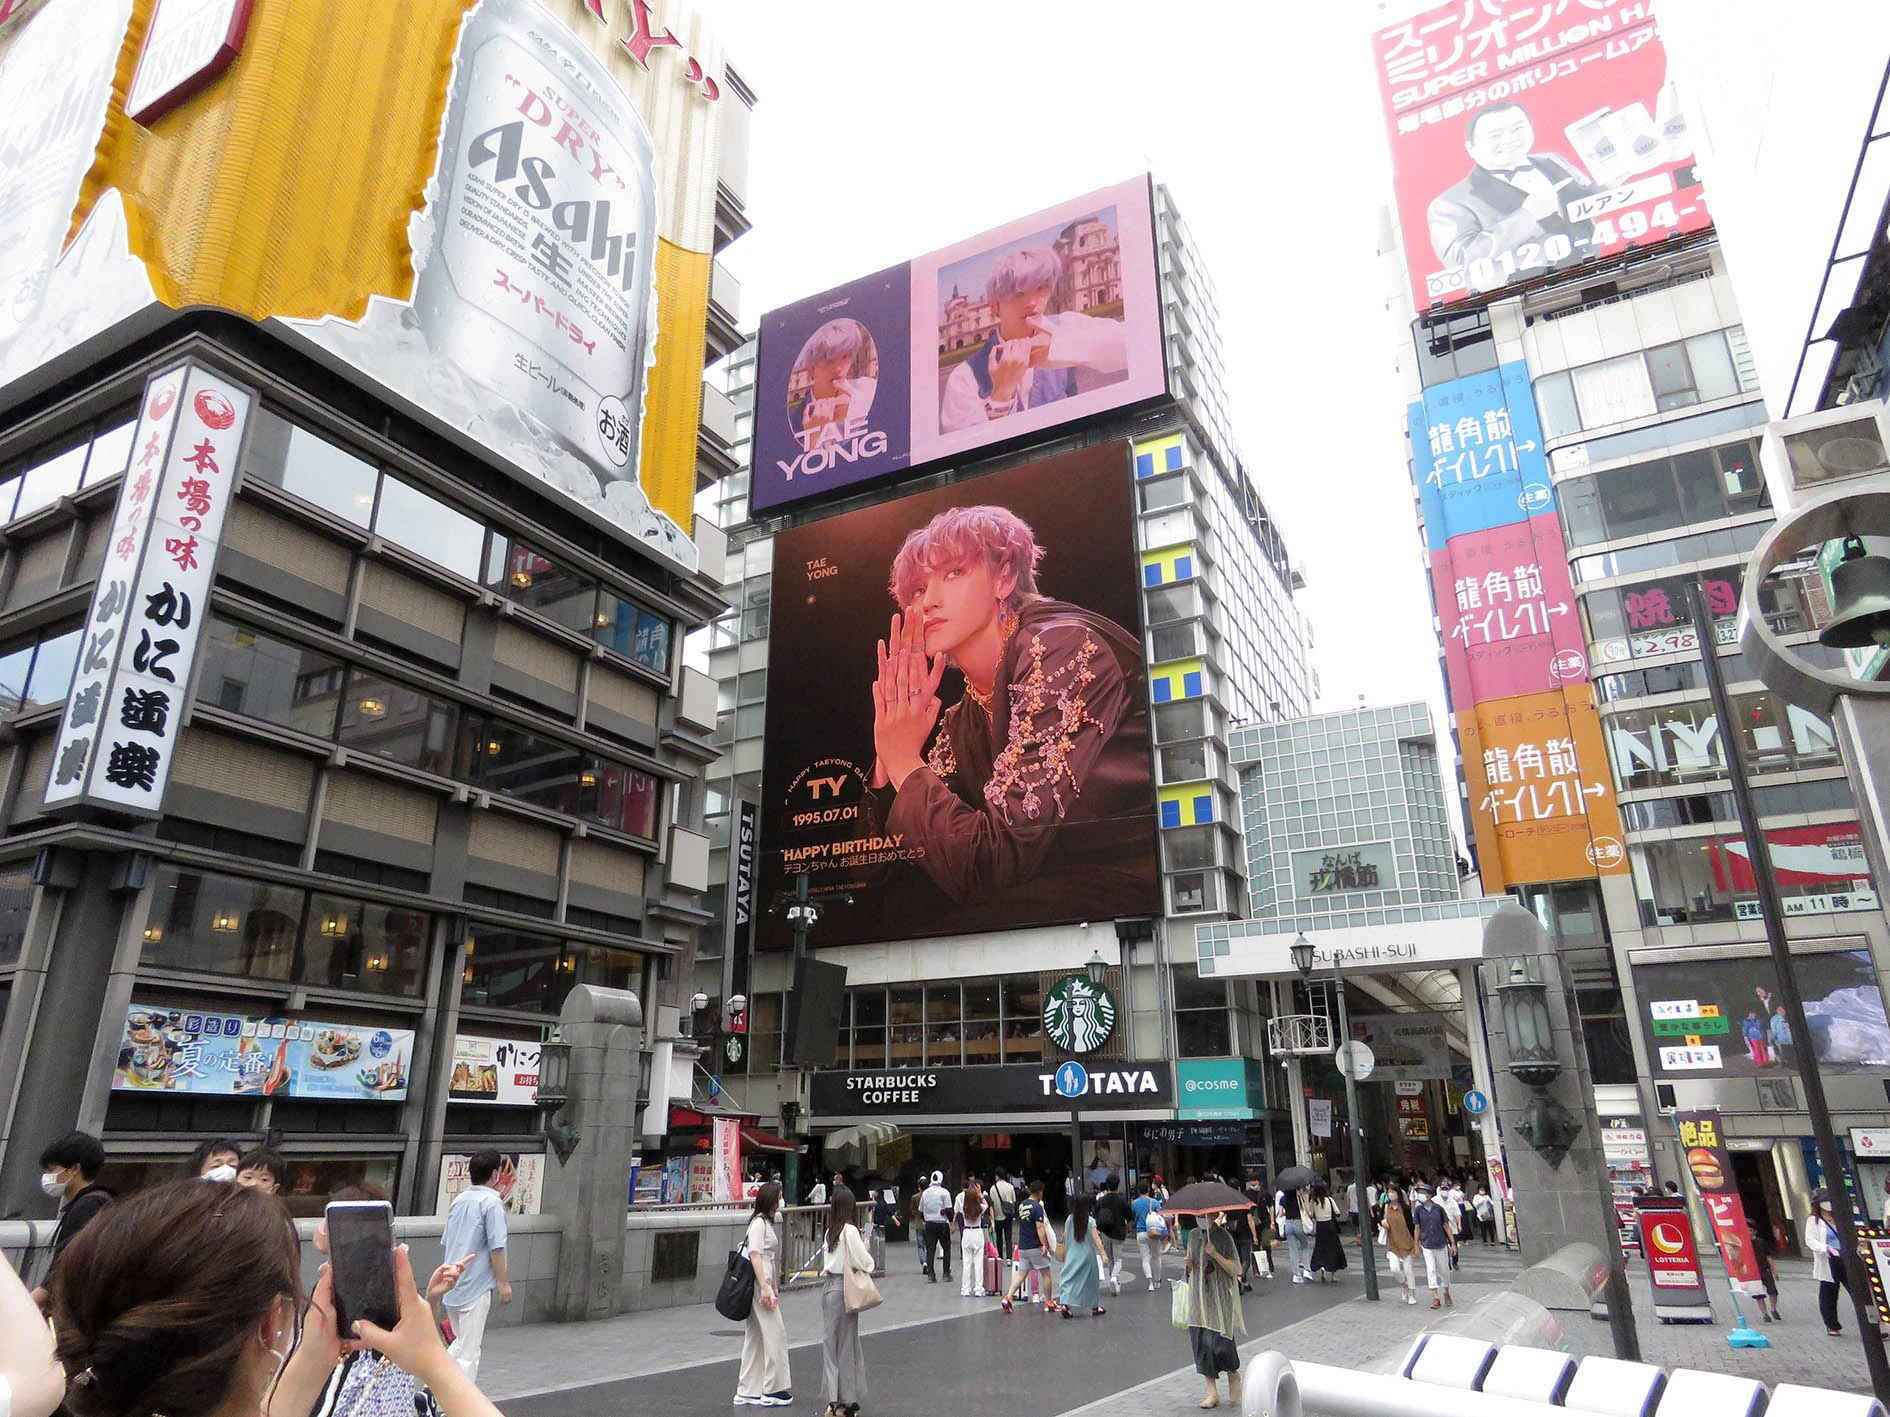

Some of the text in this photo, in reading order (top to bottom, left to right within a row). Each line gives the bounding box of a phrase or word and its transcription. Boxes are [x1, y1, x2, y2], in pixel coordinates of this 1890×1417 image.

[1391, 61, 1489, 110] SUPER
[1496, 15, 1613, 71] MILLION
[542, 86, 602, 147] SUPER
[467, 120, 637, 292] Asahi
[1575, 188, 1635, 217] ルアン
[531, 216, 561, 242] BREWED
[530, 232, 574, 290] 生
[493, 268, 597, 357] スーパードライ
[599, 408, 632, 457] お酒
[794, 414, 869, 453] TAE
[1428, 407, 1514, 457] 龍角散
[776, 431, 888, 482] YONG
[165, 437, 221, 573] 本場の味
[806, 557, 827, 571] TAE
[806, 566, 839, 581] YONG
[1454, 562, 1546, 613] 龍角散
[1552, 655, 1582, 671] 生薬
[105, 581, 192, 793] かに道楽
[787, 766, 812, 793] HAPPY
[813, 758, 853, 769] TAEYONG
[1483, 737, 1581, 786] 龍角散
[806, 774, 848, 800] TY
[792, 806, 859, 827] 1995.07.01
[783, 833, 904, 862] HAPPY BIRTHDAY
[783, 846, 926, 876] テヨンちゃん お誕生日おめでとう
[1322, 851, 1362, 868] なんば
[1588, 845, 1621, 860] 生薬
[736, 813, 754, 925] TSUTAYA
[1787, 904, 1804, 913] AM
[846, 1074, 937, 1090] STARBUCKS
[862, 1090, 920, 1104] COFFEE
[1185, 1078, 1239, 1092] @cosme
[1679, 1120, 1719, 1148] 絶品
